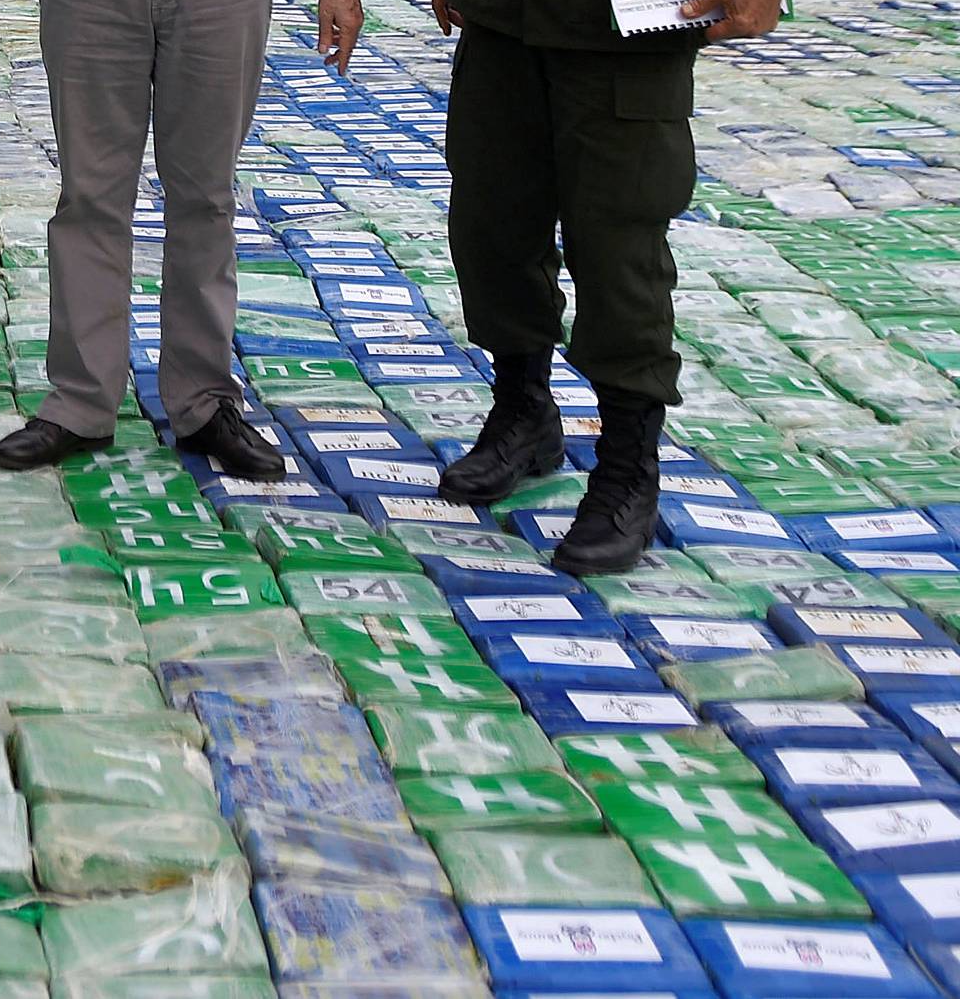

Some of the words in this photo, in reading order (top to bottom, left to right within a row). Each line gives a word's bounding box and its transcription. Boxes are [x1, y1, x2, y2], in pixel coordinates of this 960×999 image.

[410, 387, 480, 403] 54
[743, 373, 838, 400] 54
[323, 441, 397, 451] ROLEX
[731, 448, 834, 479] 54
[362, 469, 438, 486] ROLEX
[110, 501, 212, 524] 54
[430, 530, 508, 553] 54
[138, 566, 250, 606] 54
[323, 578, 403, 602] 54
